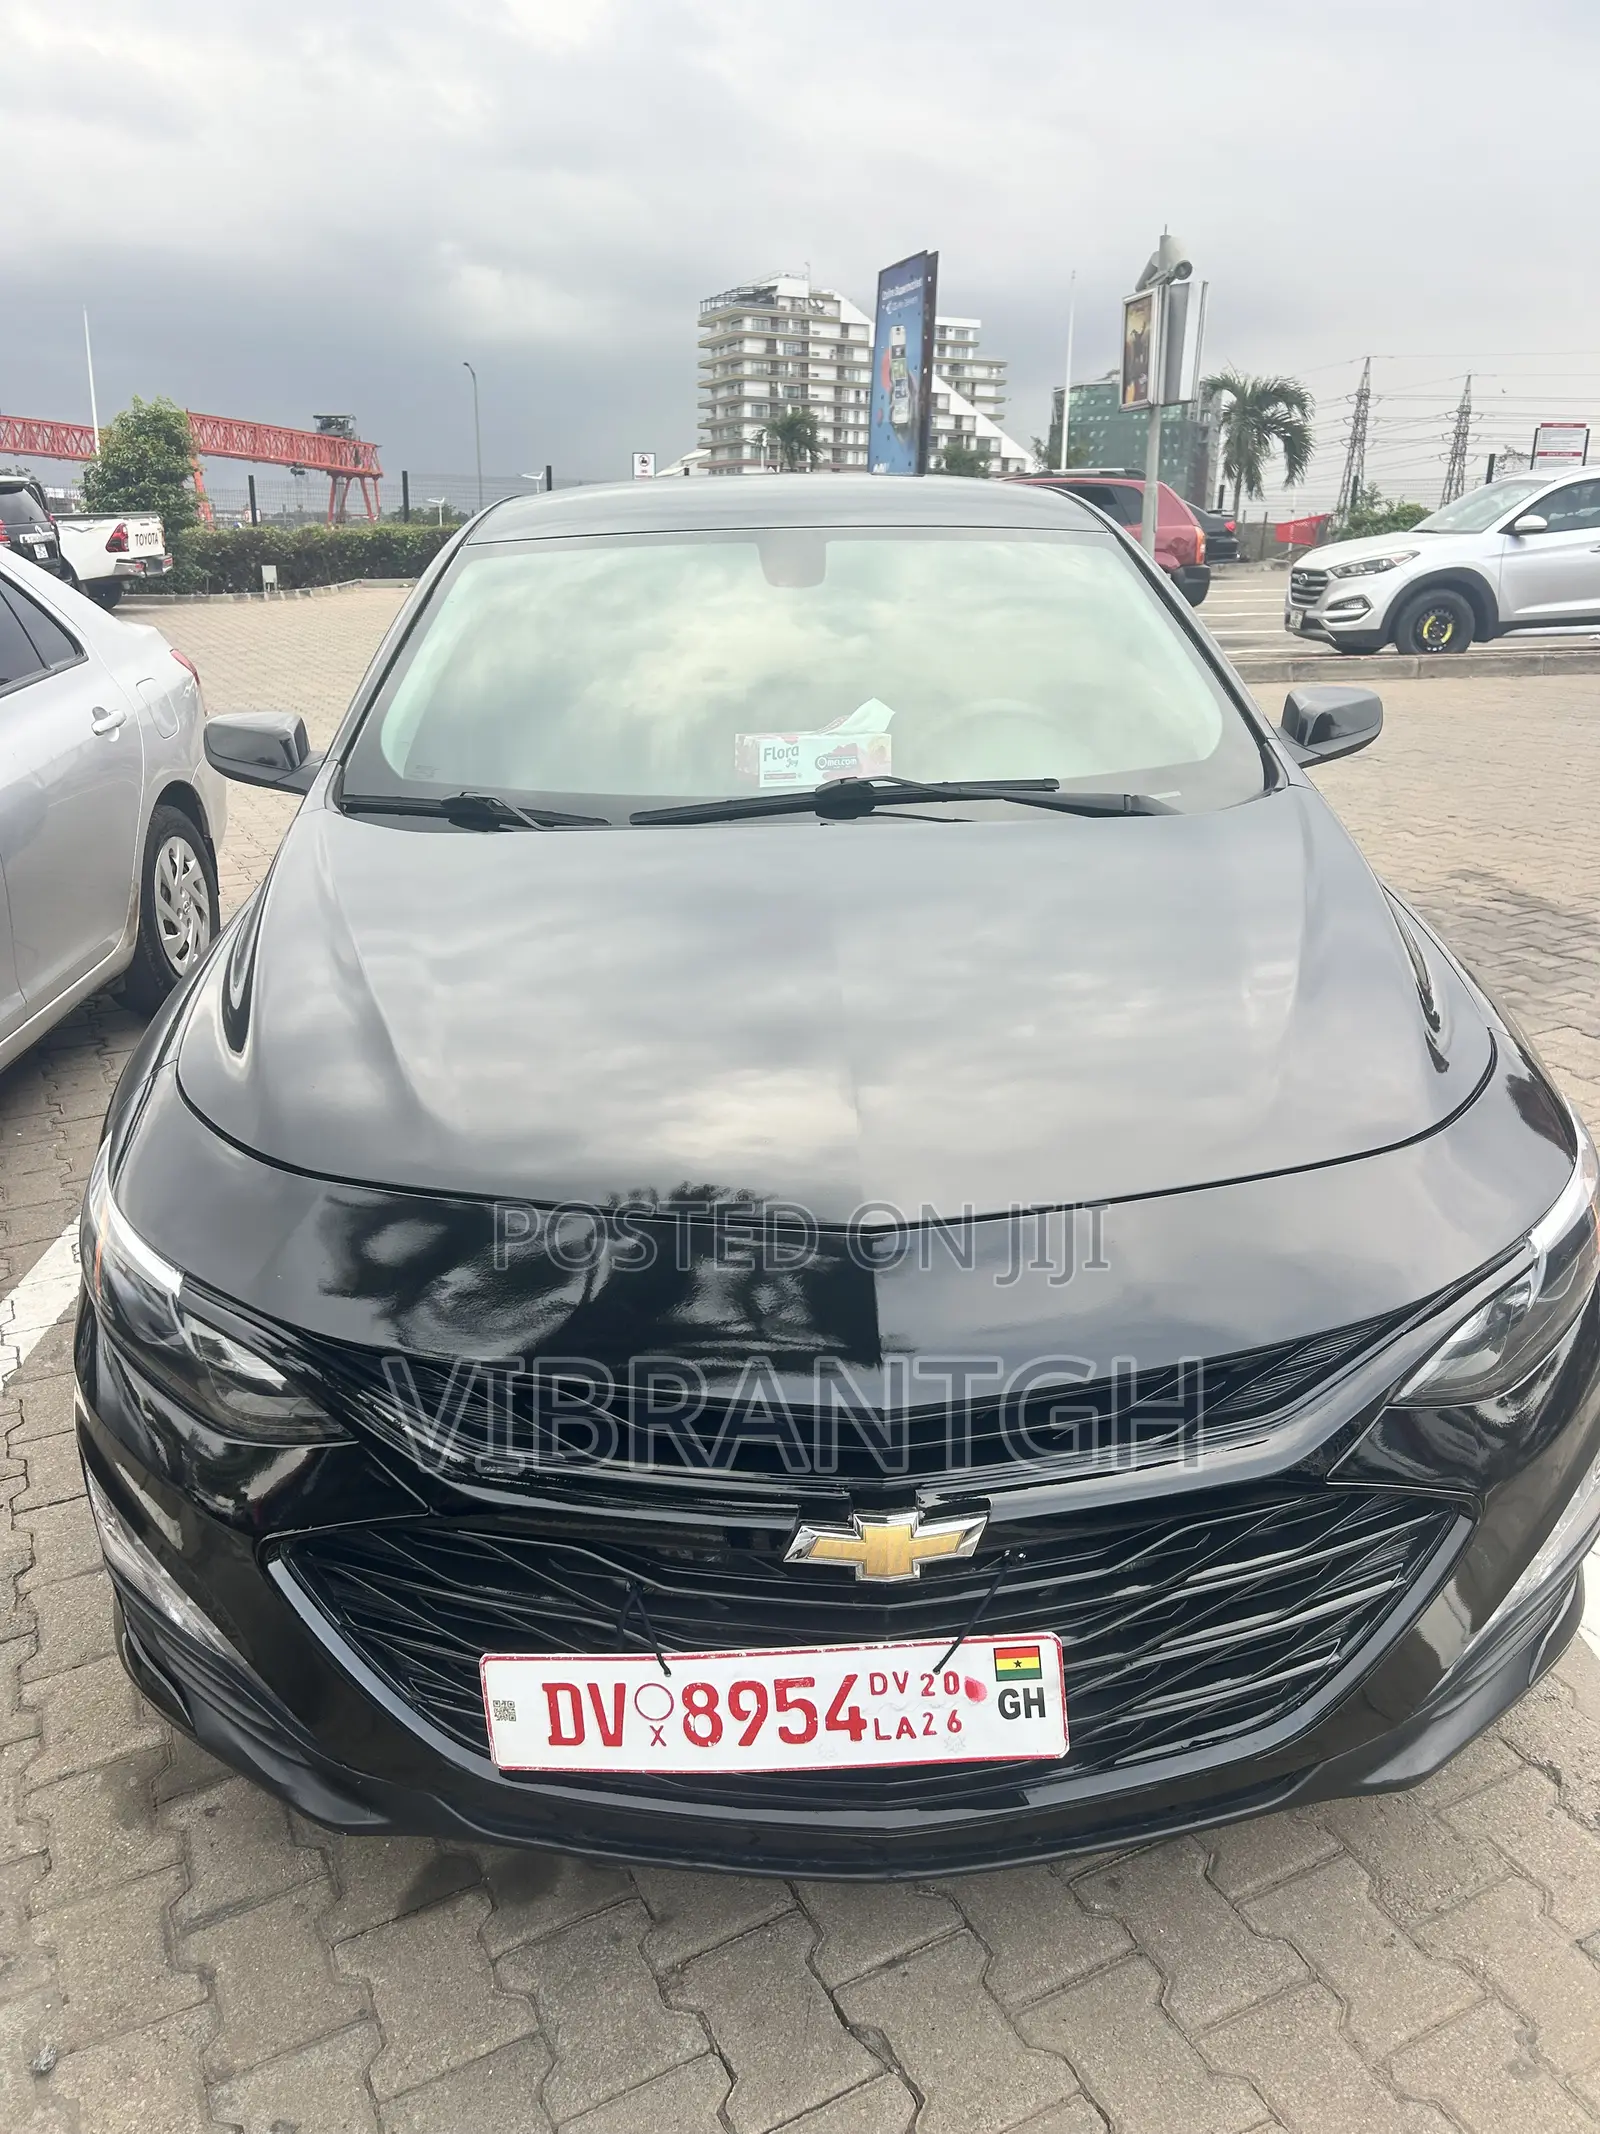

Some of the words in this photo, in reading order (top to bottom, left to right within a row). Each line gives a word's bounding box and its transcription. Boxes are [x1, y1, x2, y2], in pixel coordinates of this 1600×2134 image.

[135, 533, 159, 546] TOYOTA
[763, 746, 799, 762] Flora
[542, 1682, 627, 1747] DV
[682, 1673, 868, 1748] 8954
[998, 1687, 1046, 1720] GH
